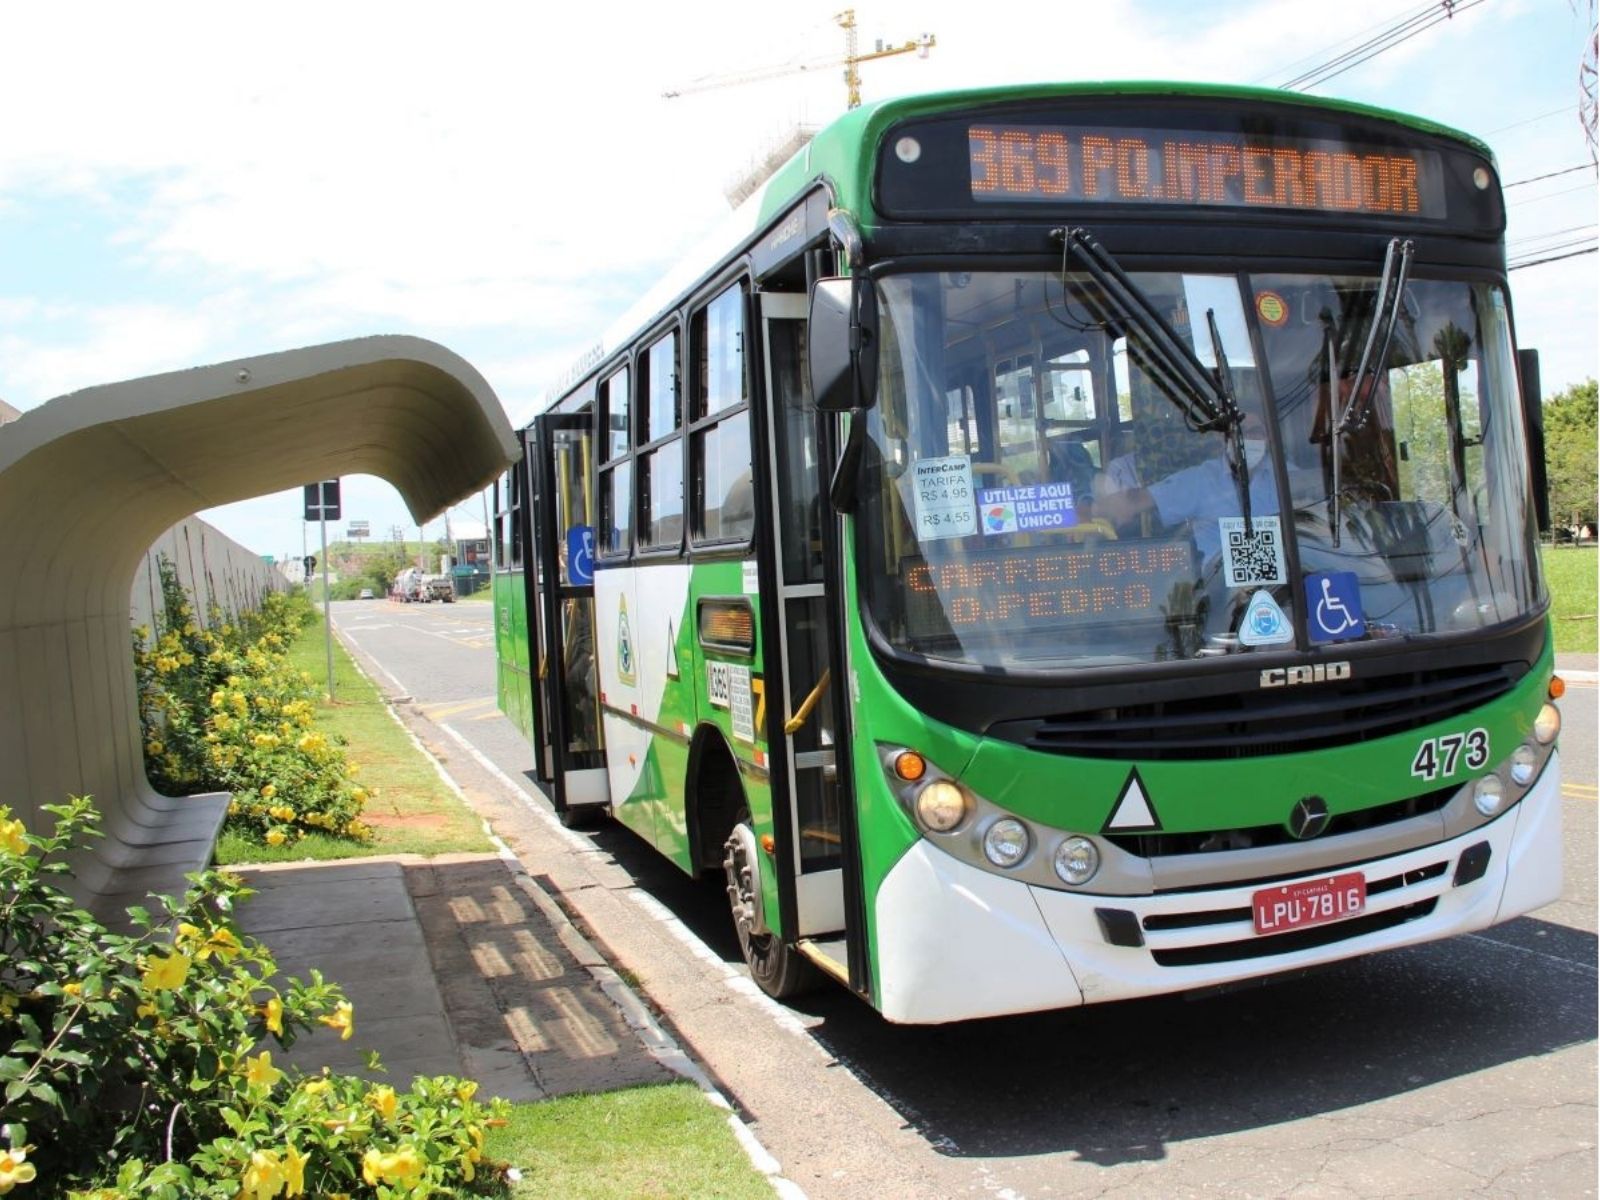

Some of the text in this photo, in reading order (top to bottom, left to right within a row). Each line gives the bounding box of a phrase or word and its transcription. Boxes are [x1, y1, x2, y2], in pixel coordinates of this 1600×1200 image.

[968, 128, 1070, 194] 369
[920, 475, 966, 488] TARIFA
[921, 491, 938, 502] R$
[984, 484, 1072, 503] UTILIZE AQUI
[1017, 497, 1073, 513] BILHETE
[923, 514, 940, 526] R$
[909, 546, 1189, 593] CARREFOUR
[1260, 661, 1351, 689] CAIO
[1411, 728, 1489, 781] 473
